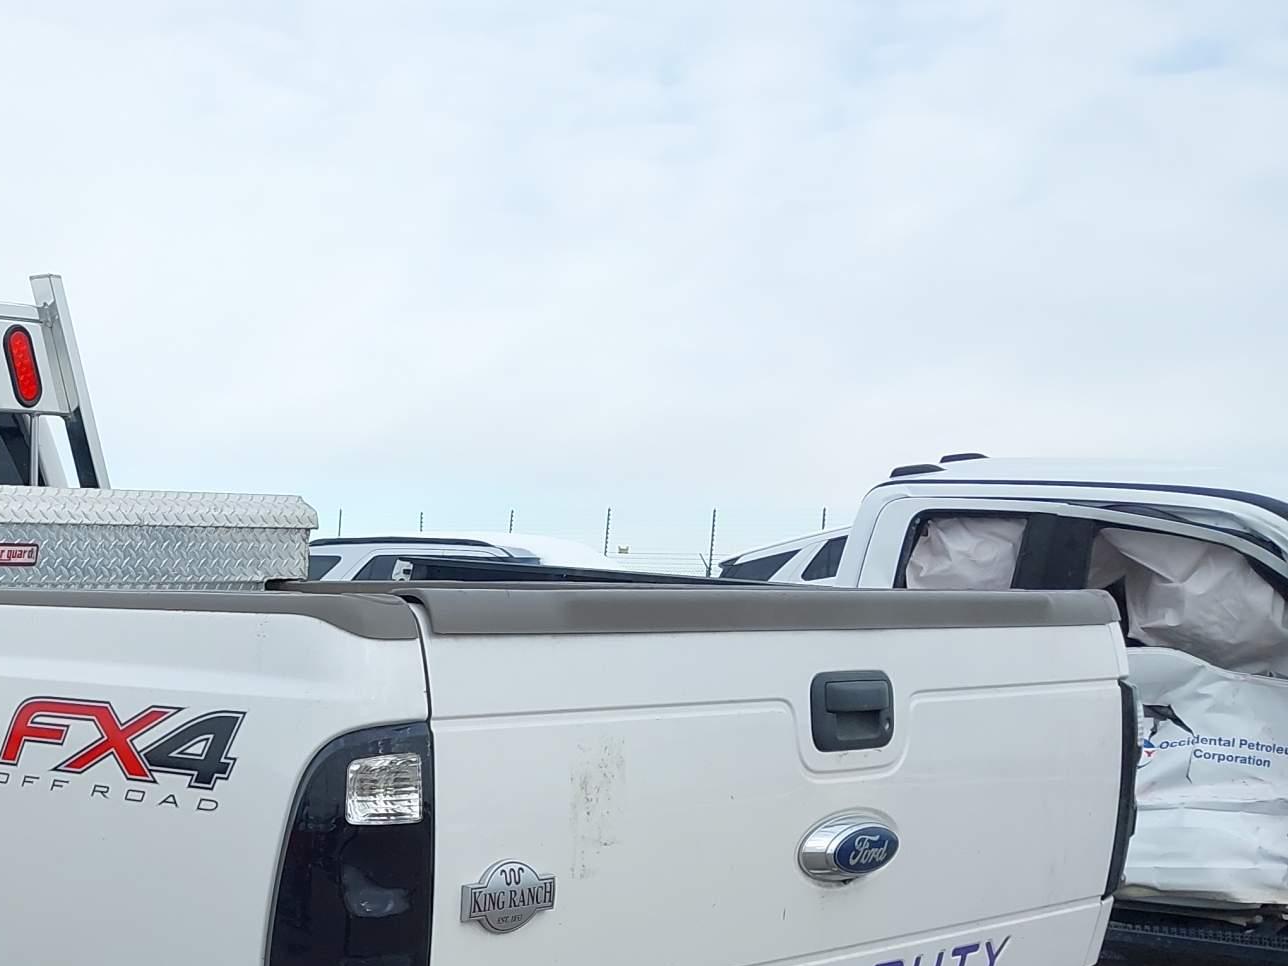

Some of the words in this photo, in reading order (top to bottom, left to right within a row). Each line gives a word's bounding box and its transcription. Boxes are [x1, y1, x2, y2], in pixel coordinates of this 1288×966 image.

[6, 548, 34, 560] guard
[1159, 735, 1235, 750] Occidental
[1193, 748, 1271, 768] Corporation
[91, 785, 218, 811] ROAD
[849, 835, 889, 866] Ford
[472, 891, 505, 913] KING
[508, 881, 553, 909] RANCH
